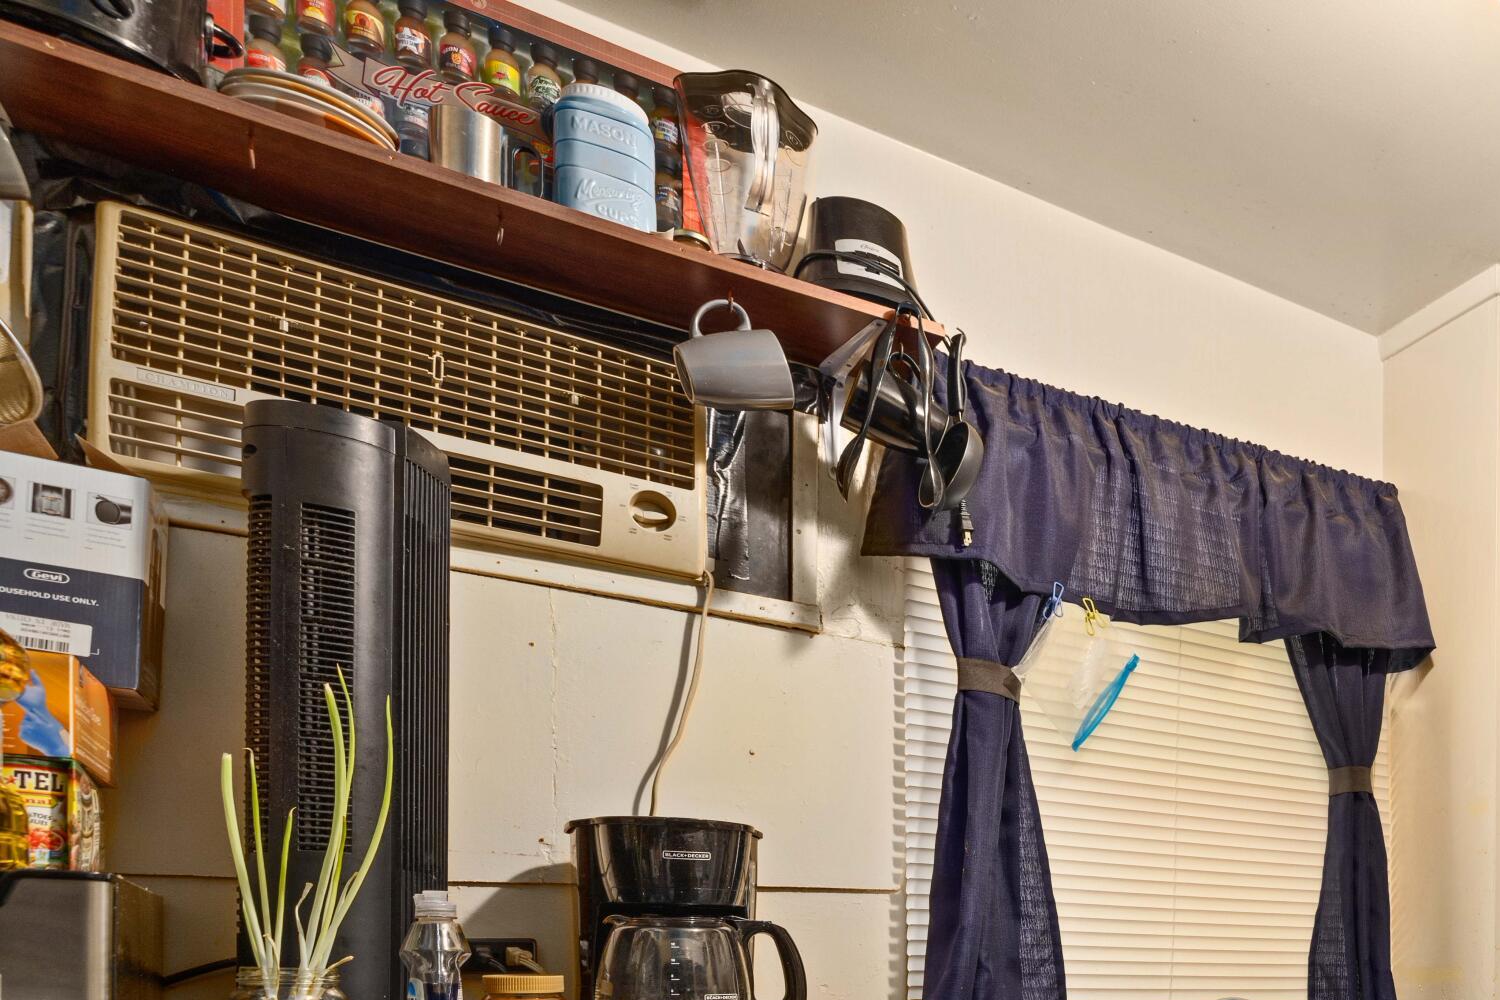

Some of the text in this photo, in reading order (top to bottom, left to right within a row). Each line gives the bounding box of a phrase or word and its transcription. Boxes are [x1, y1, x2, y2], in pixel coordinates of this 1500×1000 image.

[373, 65, 536, 126] Hot Sauce
[570, 115, 637, 147] MASON
[144, 372, 230, 399] CHAMPION
[31, 569, 64, 582] Gevi
[0, 586, 100, 607] OUSEHOLD USE ONLY.
[13, 769, 64, 793] TEL
[664, 852, 710, 860] BLACK+DECKER
